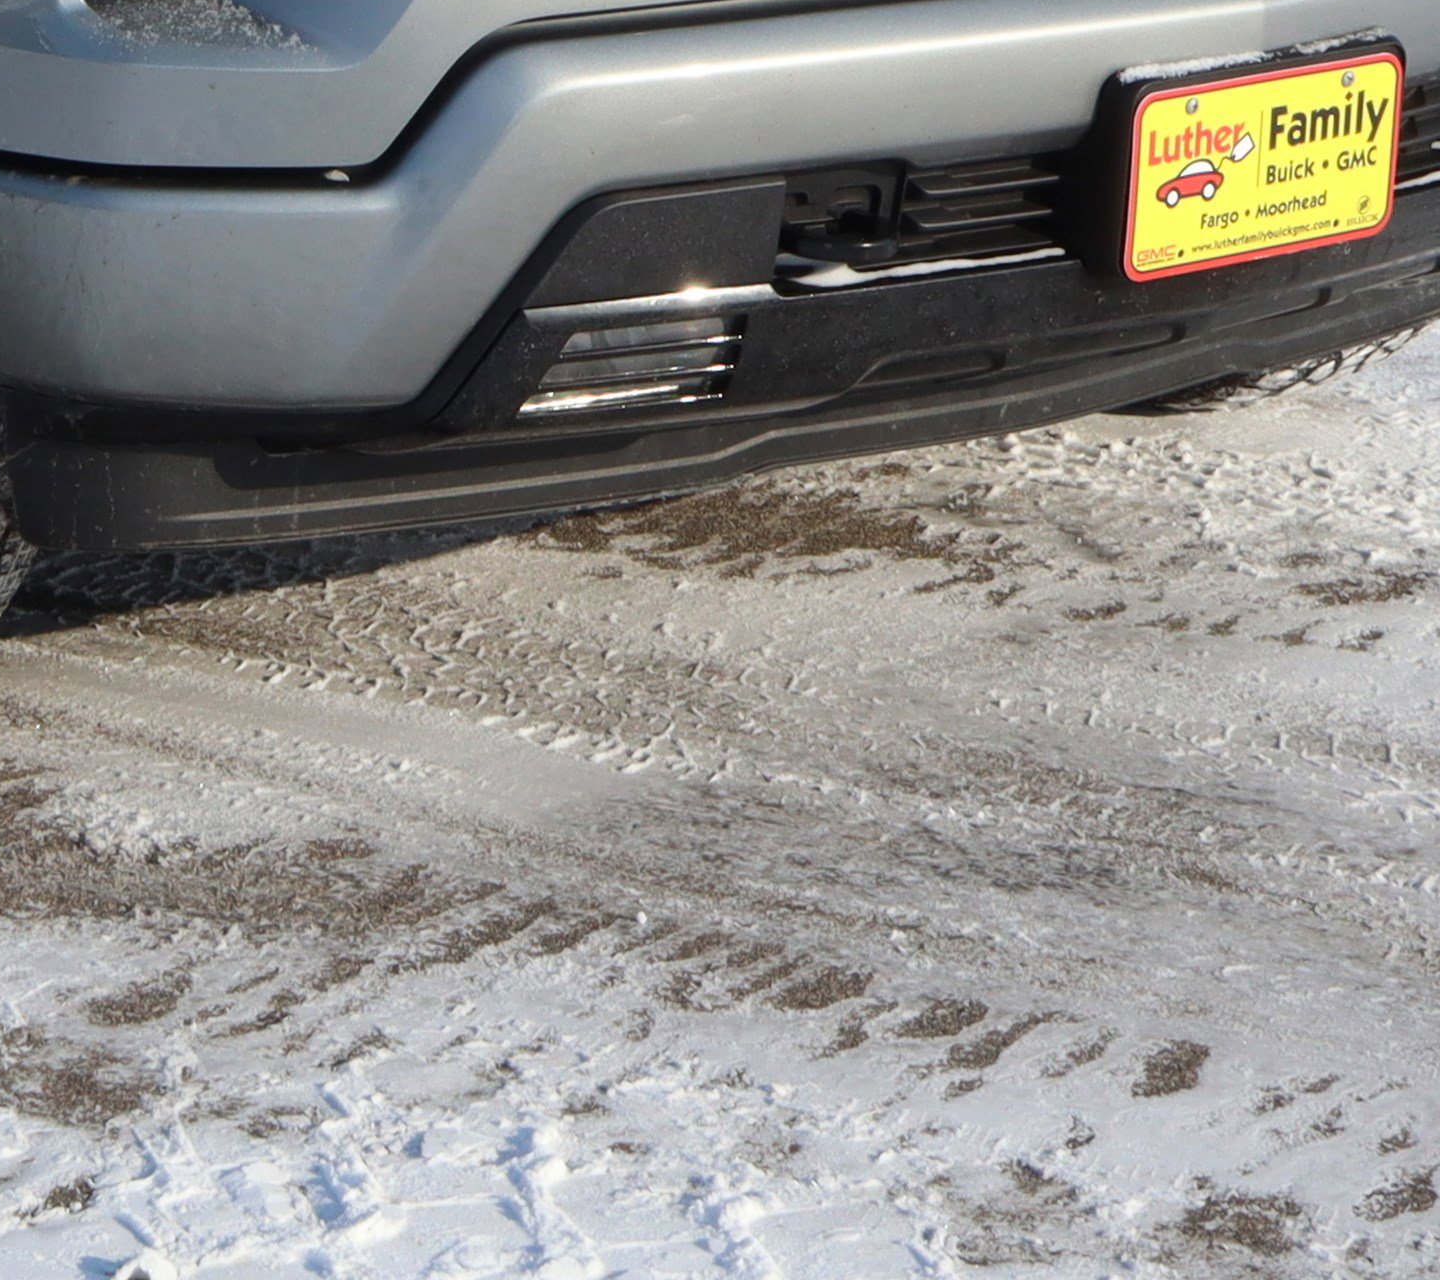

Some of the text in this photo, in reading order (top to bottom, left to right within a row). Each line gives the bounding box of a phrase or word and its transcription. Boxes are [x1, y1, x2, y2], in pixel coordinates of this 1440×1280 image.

[1269, 89, 1389, 151] Family
[1148, 120, 1246, 167] Luther
[1265, 145, 1378, 186] Buick GMC
[1200, 190, 1328, 230] Fargo Moorhead
[1137, 244, 1177, 263] GMC
